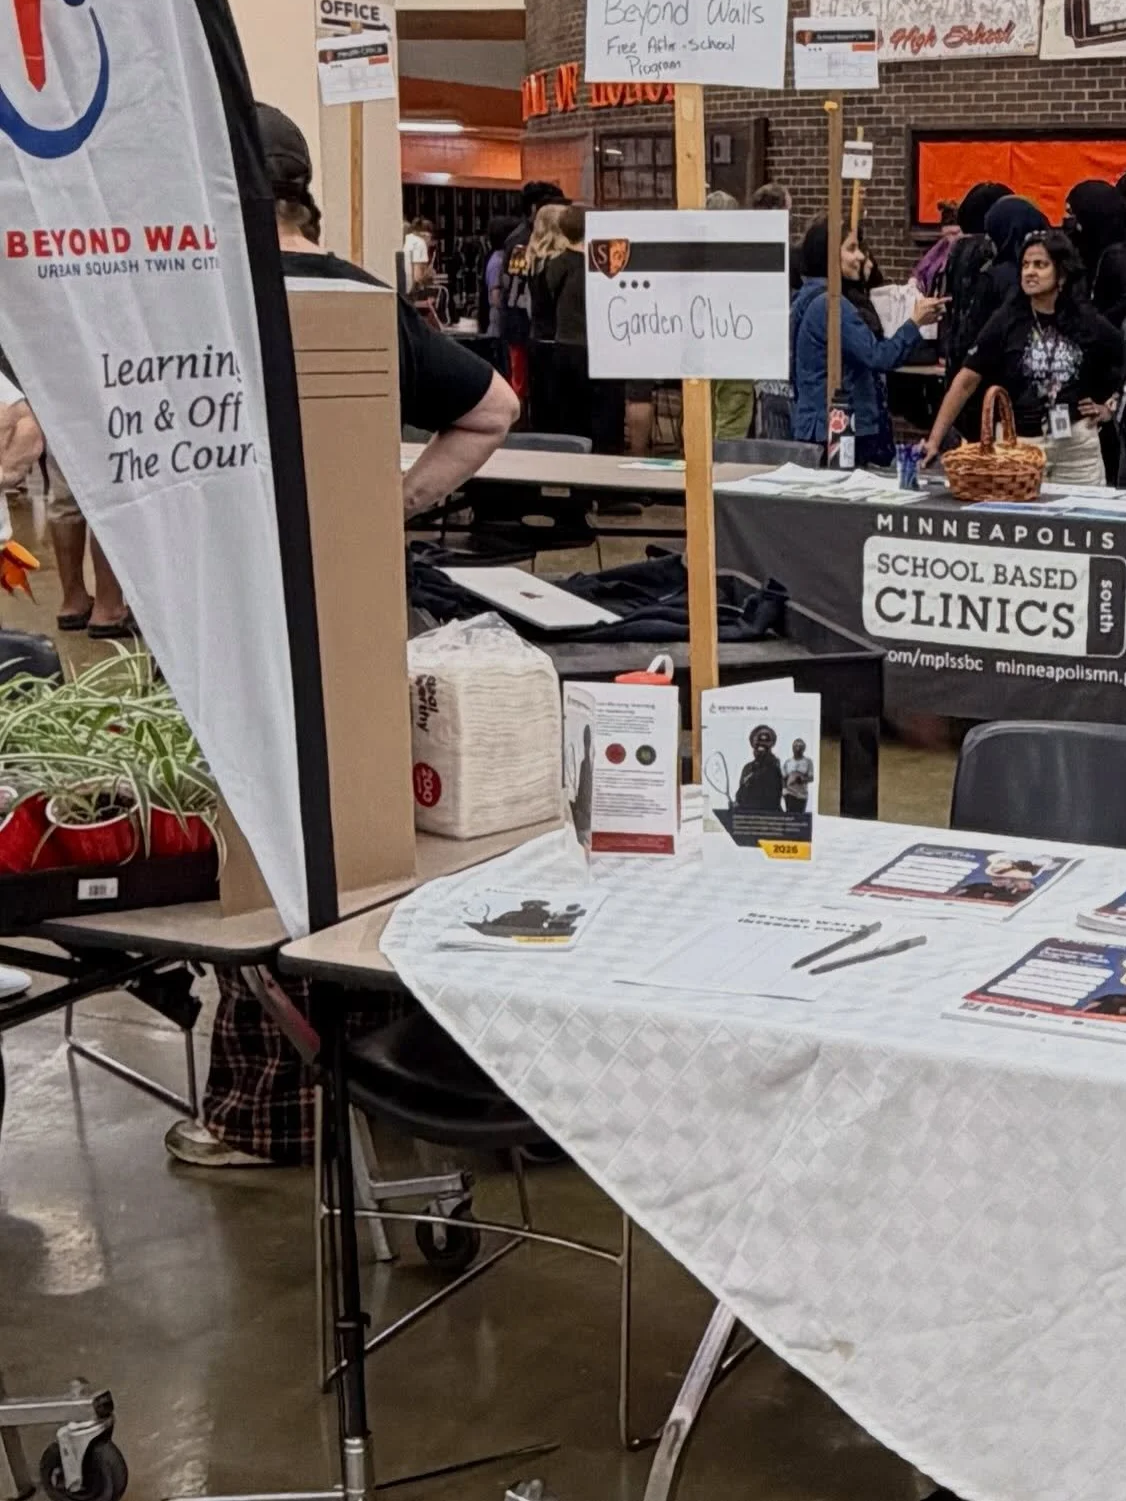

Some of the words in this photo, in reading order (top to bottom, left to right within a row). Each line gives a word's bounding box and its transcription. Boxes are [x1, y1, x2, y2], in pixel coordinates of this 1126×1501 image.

[606, 36, 637, 55] Free
[890, 25, 936, 53] High
[942, 20, 1016, 47] School
[625, 55, 680, 79] Program
[6, 225, 131, 258] BEYOND
[144, 225, 217, 251] WAL
[86, 259, 139, 276] SQUASH
[145, 258, 185, 273] TWIN
[608, 296, 683, 345] Garden
[690, 295, 753, 340] Club
[108, 405, 143, 440] On
[154, 399, 175, 432] &
[188, 392, 243, 432] Off
[108, 446, 159, 484] The
[877, 513, 1115, 550] MINNEAPOLIS
[876, 553, 984, 585] SCHOOL
[992, 565, 1078, 591] BASED
[875, 586, 1076, 640] CLINICS
[1101, 579, 1116, 634] south
[420, 766, 434, 803] 200
